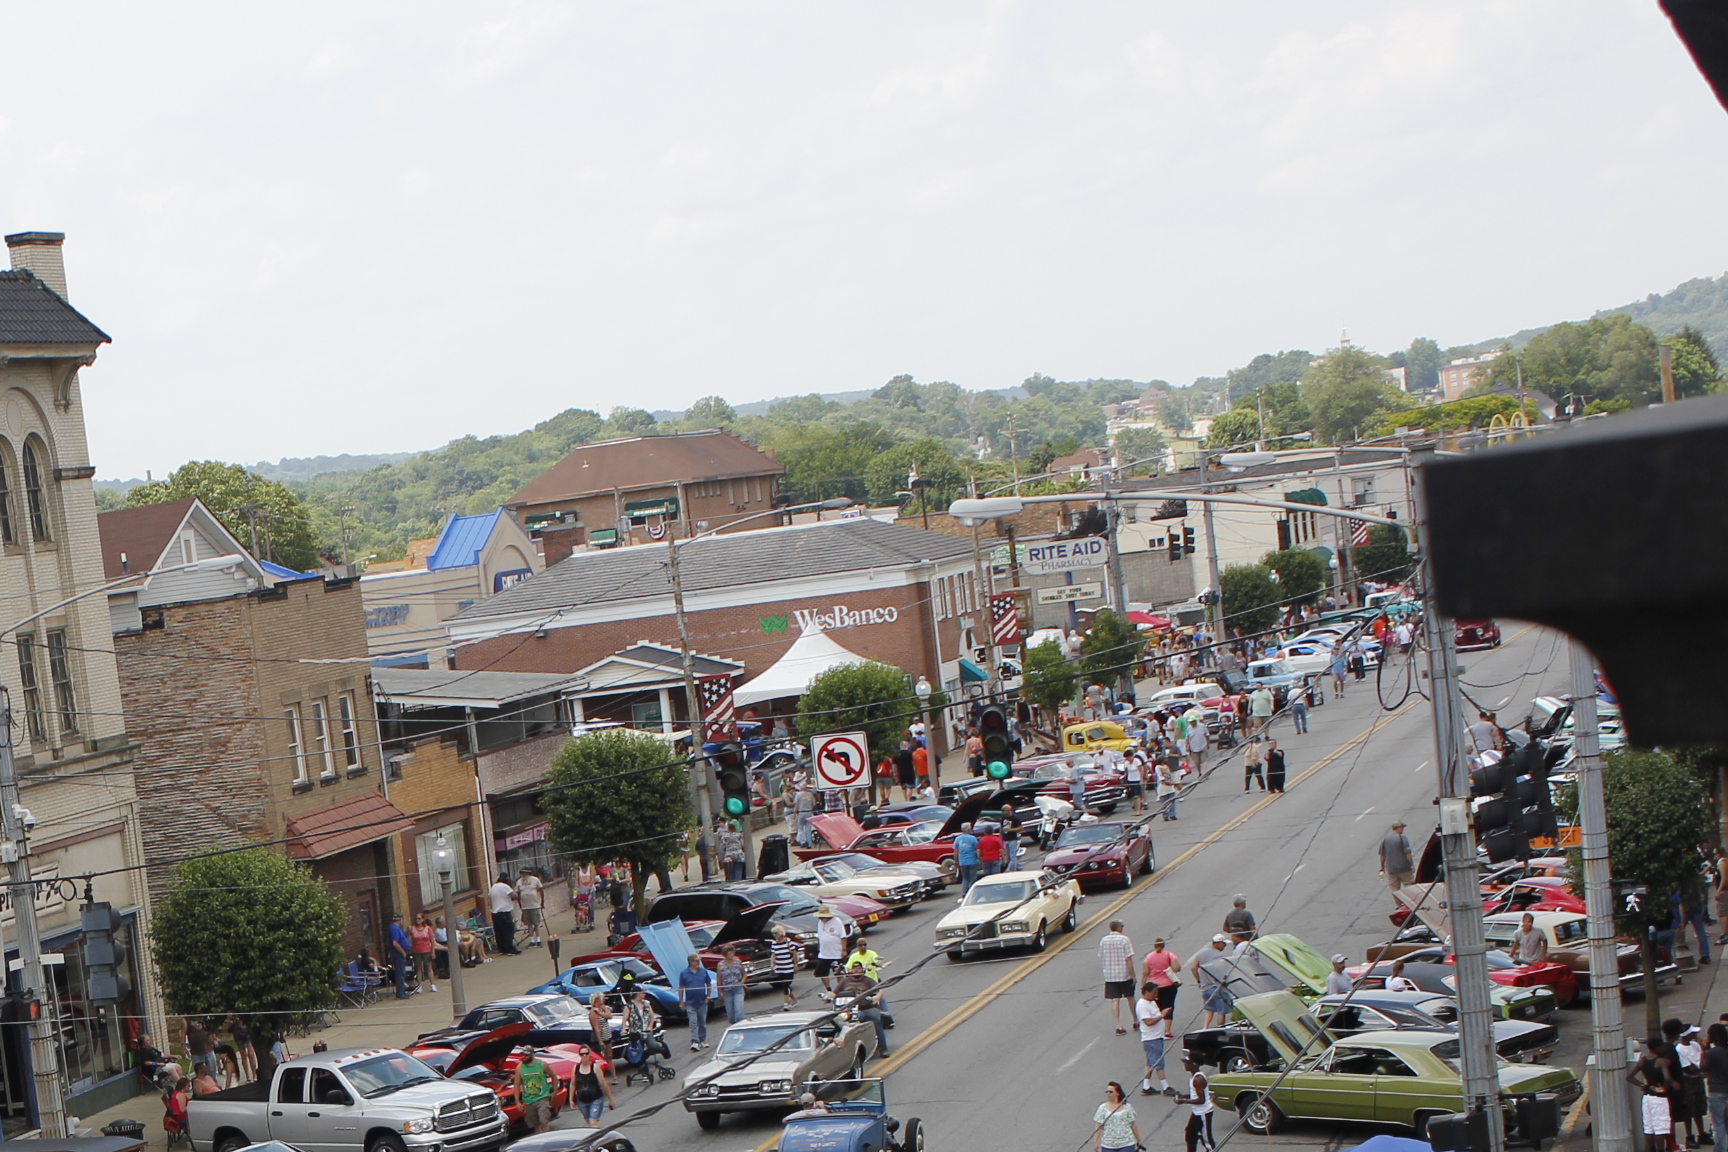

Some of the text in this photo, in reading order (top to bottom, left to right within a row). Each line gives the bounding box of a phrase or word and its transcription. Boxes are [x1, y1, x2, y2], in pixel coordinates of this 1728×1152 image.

[1029, 545, 1067, 561] RITE
[1072, 541, 1102, 556] AID
[1041, 558, 1093, 571] PHARMACY
[793, 605, 898, 632] WesBanco
